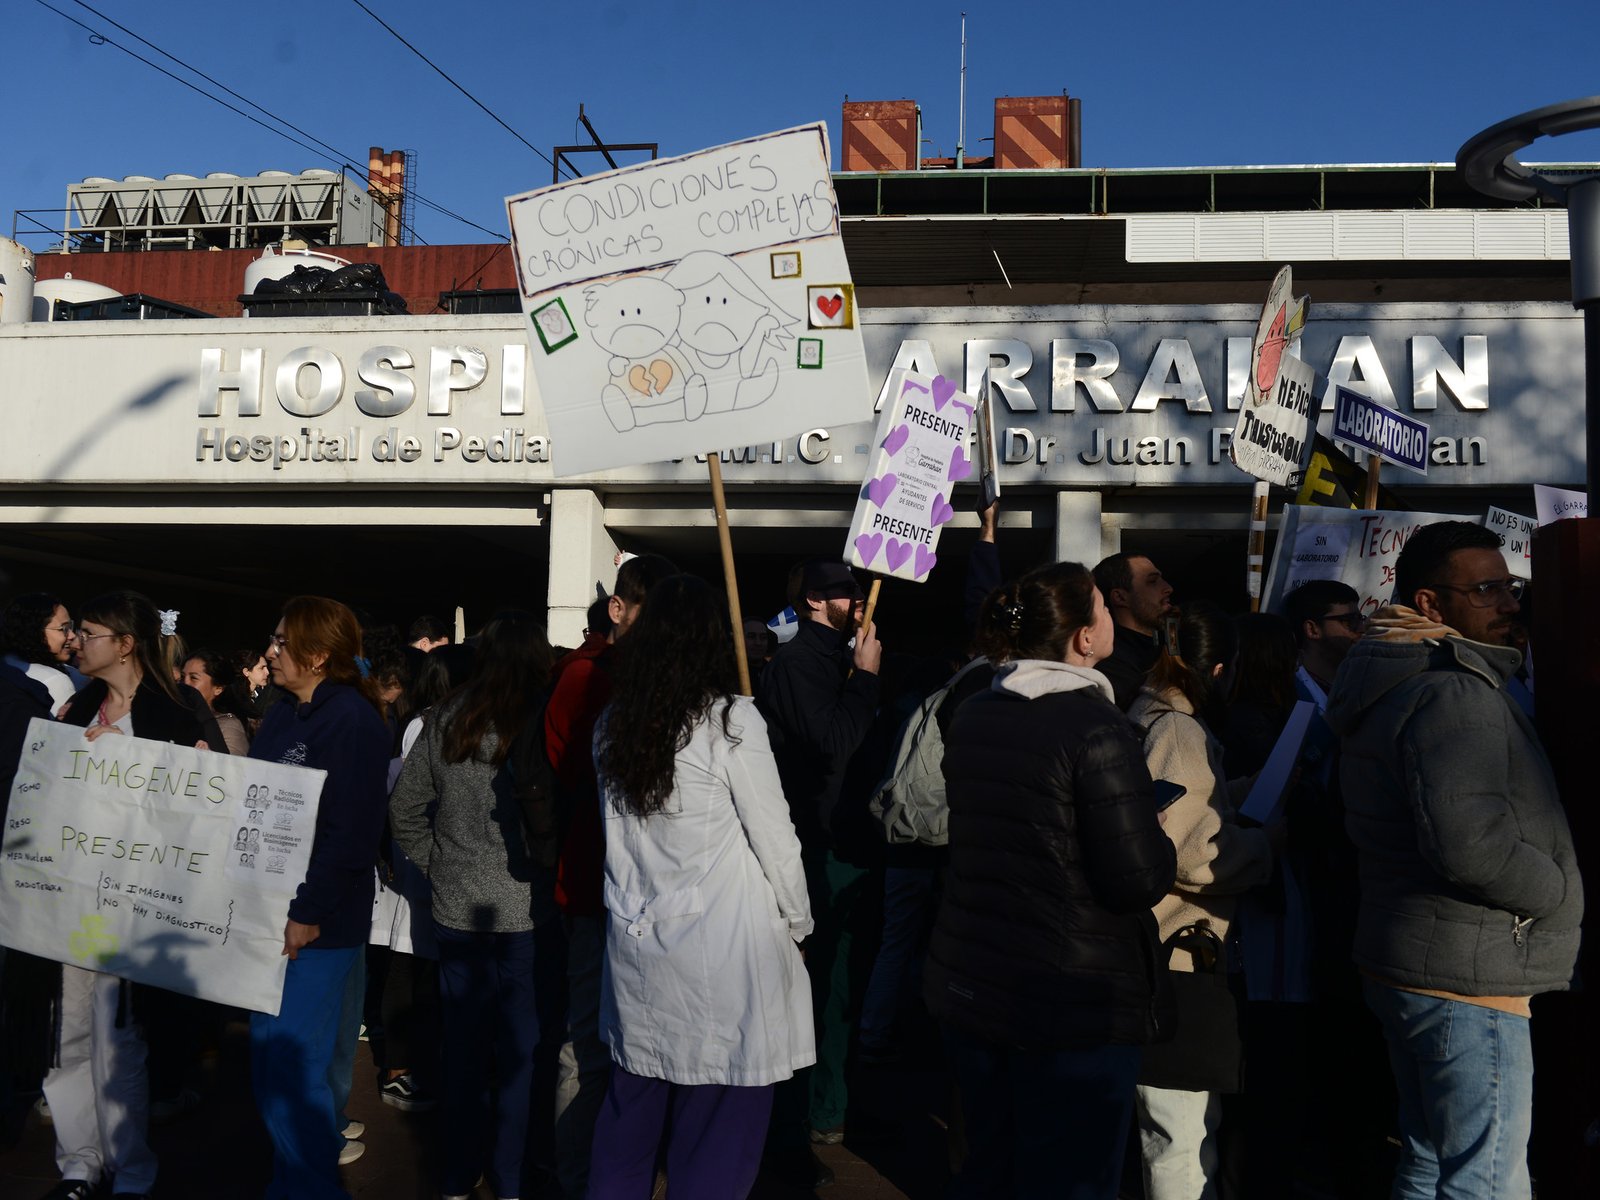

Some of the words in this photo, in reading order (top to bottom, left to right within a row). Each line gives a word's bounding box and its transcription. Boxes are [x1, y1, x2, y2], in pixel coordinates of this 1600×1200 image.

[538, 154, 777, 237] CONDICIONES
[527, 224, 663, 278] CRÓNICAS
[698, 180, 838, 238] COMPLEJAS
[198, 344, 526, 417] HOSPI
[874, 335, 1490, 414] ARRAAN
[904, 404, 964, 441] PRESENTE
[1338, 397, 1424, 462] LABORATORIO
[196, 427, 360, 470] Hospital
[371, 427, 422, 462] de
[434, 427, 551, 462] Pedia
[1005, 427, 1064, 464] Dr.
[1079, 427, 1192, 465] Juan
[918, 458, 942, 474] Garrahan
[899, 497, 906, 505] DE
[905, 499, 925, 511] SERVICIO
[902, 488, 927, 502] AYUDANTES
[1563, 500, 1588, 511] GARRA
[873, 513, 933, 545] PRESENTE
[1491, 510, 1506, 525] NO
[1506, 515, 1518, 530] ES
[1520, 520, 1534, 535] UN
[1315, 535, 1327, 546] SIN
[1510, 539, 1523, 554] UN
[1296, 554, 1339, 563] LABORATORIO
[63, 750, 226, 804] IMAGENES
[62, 826, 209, 874] PRESENTE
[103, 898, 119, 908] NO
[132, 904, 148, 918] HAY
[126, 884, 183, 904] IMAGENES
